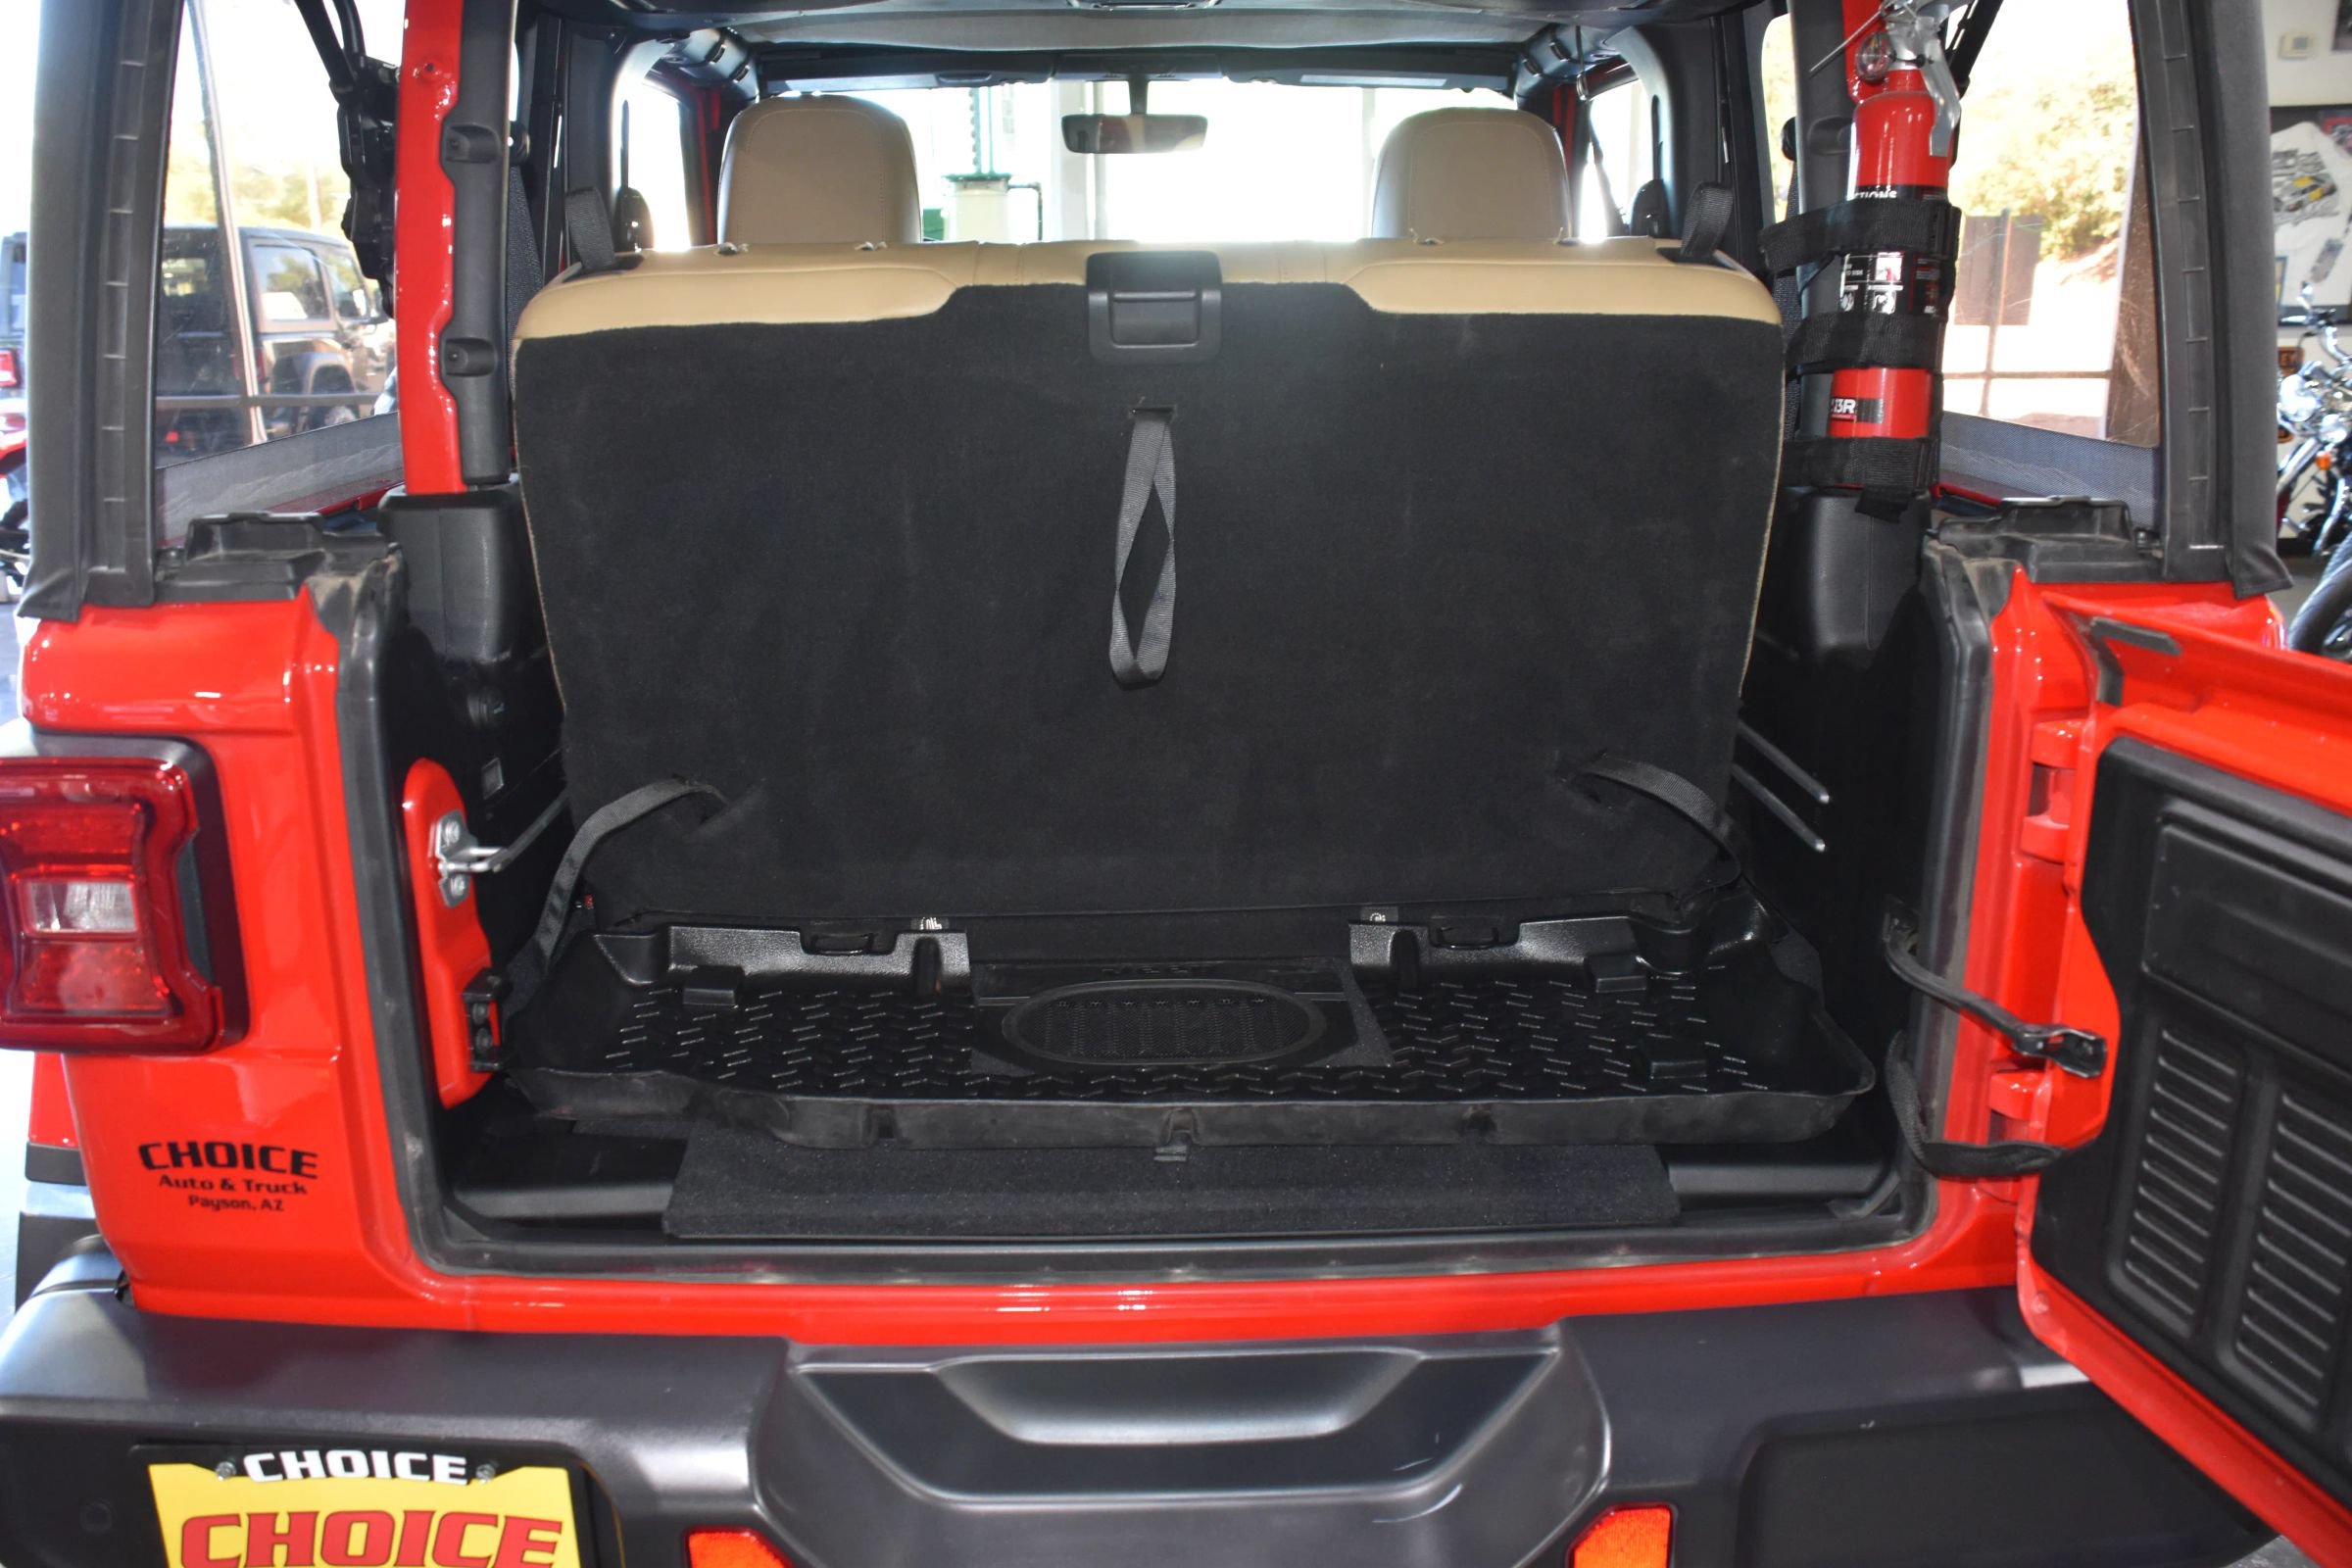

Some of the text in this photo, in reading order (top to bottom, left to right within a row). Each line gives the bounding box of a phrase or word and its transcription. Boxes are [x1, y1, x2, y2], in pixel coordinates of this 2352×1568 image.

[138, 1141, 318, 1180] CHOICE
[159, 1174, 308, 1195] Auto & Truck
[188, 1195, 285, 1212] Payson, AZ
[243, 1449, 468, 1486] CHOICE
[180, 1509, 564, 1568] CHOICE
